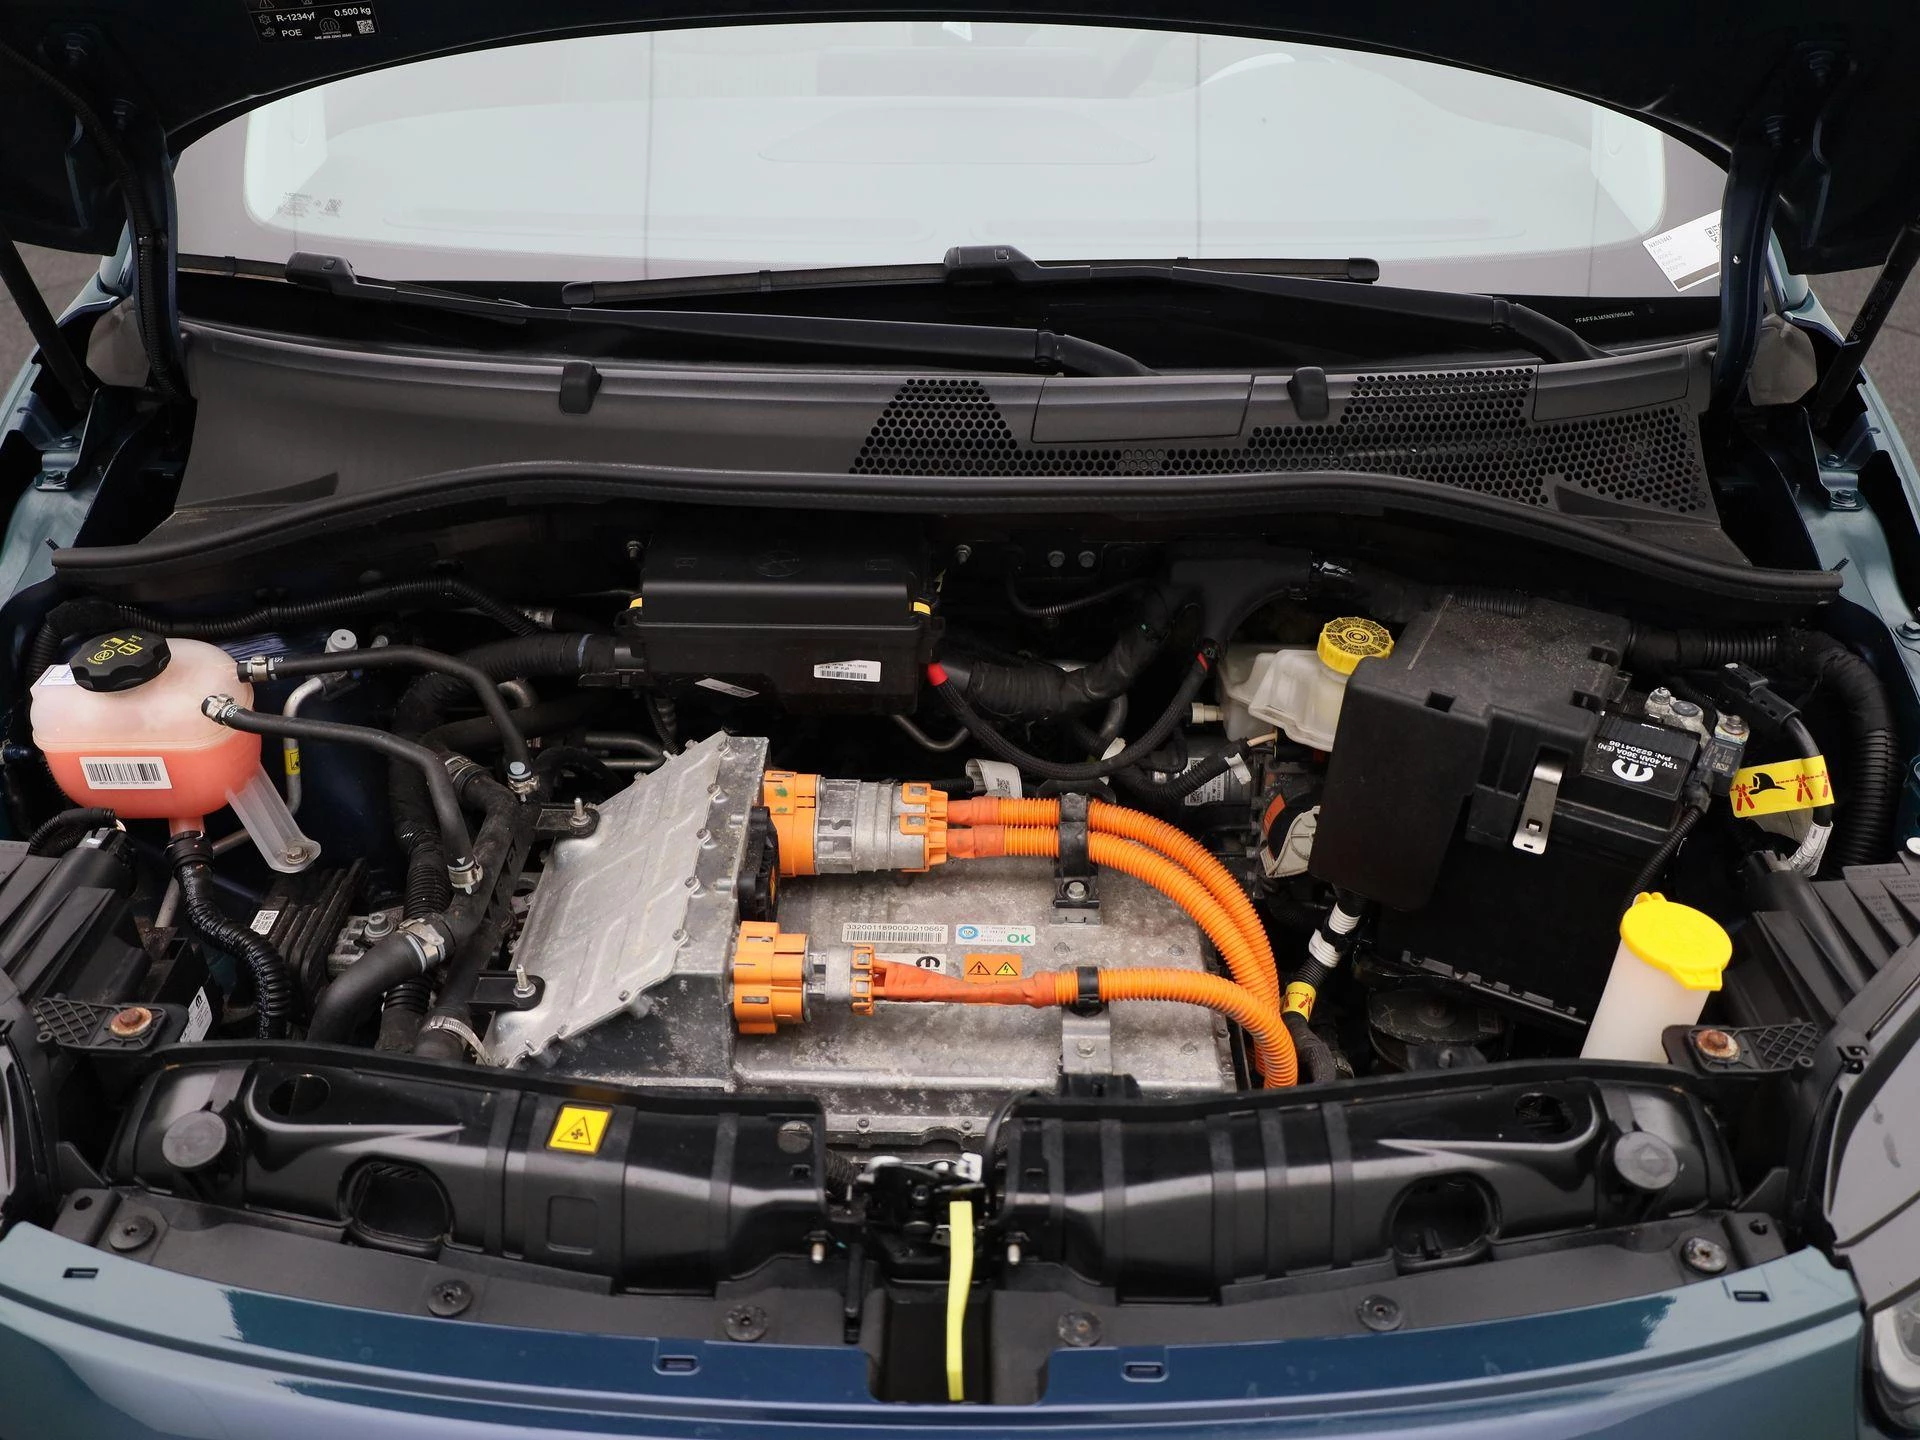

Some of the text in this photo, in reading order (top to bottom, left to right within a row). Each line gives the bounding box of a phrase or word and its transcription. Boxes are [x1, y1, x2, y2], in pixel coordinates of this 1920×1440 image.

[276, 6, 371, 22] R-1234yf 0.500 kg
[281, 28, 303, 37] POE
[1597, 742, 1615, 752] (EN)
[1639, 754, 1661, 765] 40Ah
[1654, 752, 1672, 762] PN:
[1661, 761, 1678, 770] 12V
[1006, 933, 1032, 944] OK
